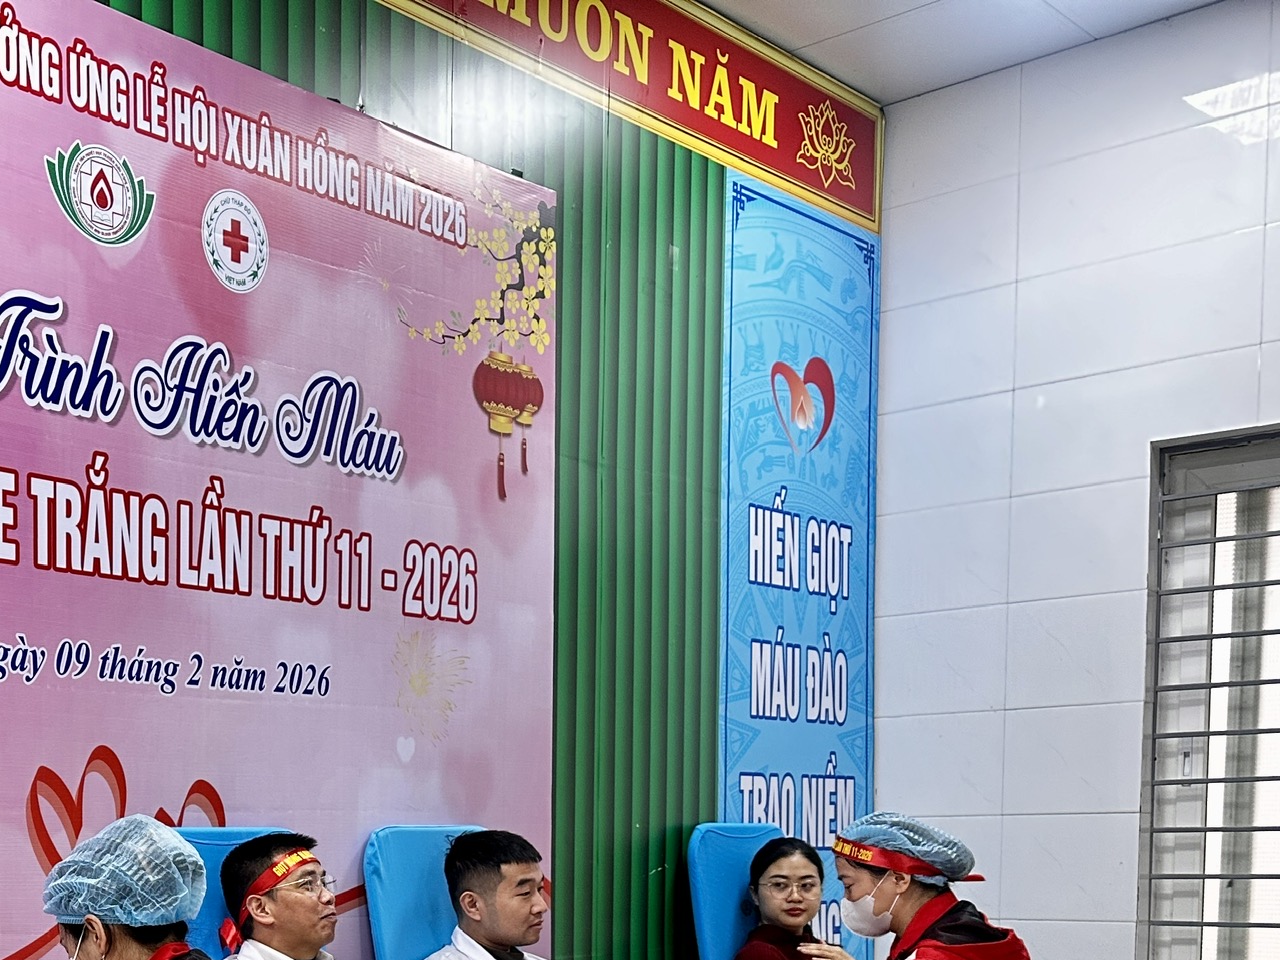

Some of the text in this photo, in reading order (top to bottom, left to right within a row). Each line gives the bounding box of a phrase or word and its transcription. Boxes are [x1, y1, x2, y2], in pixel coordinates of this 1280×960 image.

[67, 52, 129, 122] ỨNG
[134, 64, 168, 138] LỄ
[173, 94, 218, 164] HỘI
[223, 114, 291, 184] XUÂN
[296, 122, 361, 206] HỒNG
[365, 165, 416, 230] NĂM
[419, 187, 468, 248] 2026
[667, 38, 780, 149] NĂM
[135, 338, 267, 449] Hiến
[278, 374, 404, 477] Máu
[29, 453, 168, 585] TRẮNG
[177, 477, 252, 595] LẦN
[260, 506, 330, 605] THỨ
[335, 530, 372, 610] 11
[404, 541, 478, 624] 2026
[748, 487, 853, 614] HIẾN GIỌT
[56, 641, 90, 678] 09
[99, 647, 180, 694] tháng
[187, 654, 203, 687] 2
[211, 658, 266, 692] năm
[273, 662, 332, 697] 2026
[750, 627, 849, 726] MÁU ĐÀO
[739, 753, 856, 849] TRAO NIỀM
